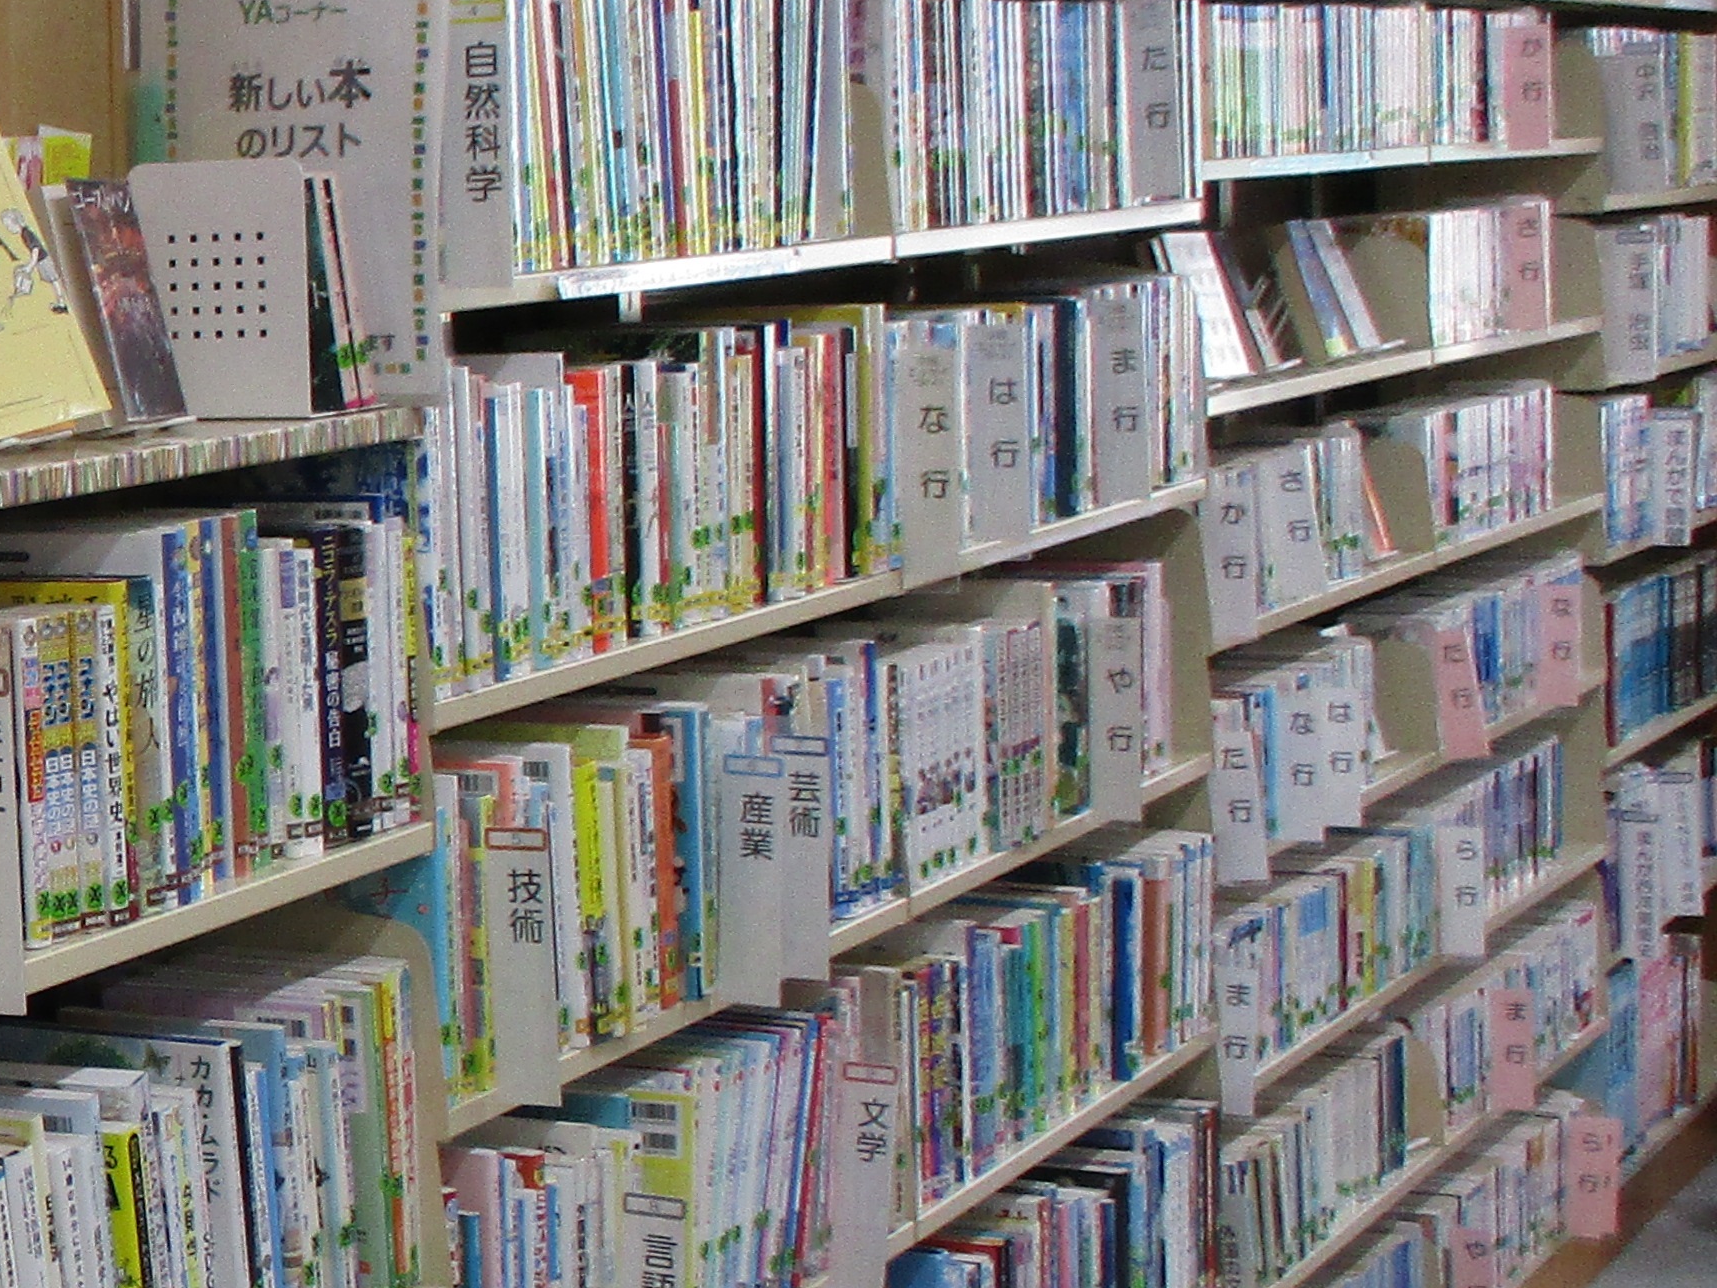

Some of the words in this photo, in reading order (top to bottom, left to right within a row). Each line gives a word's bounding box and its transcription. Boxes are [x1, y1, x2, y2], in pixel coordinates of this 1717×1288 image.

[238, 0, 348, 25] YAコーナー
[229, 58, 373, 112] 新しい本
[464, 41, 502, 203] 自然科学
[236, 122, 363, 160] のリスト
[987, 375, 1020, 469] は行
[1111, 346, 1138, 433] ま行
[918, 404, 952, 500] な行
[1219, 501, 1248, 581] か行
[1279, 468, 1312, 543] さ行
[1106, 666, 1134, 752] や行
[1327, 699, 1355, 774] は行
[1219, 746, 1253, 824] た行
[1289, 711, 1315, 787] な行
[739, 791, 774, 861] 産業
[787, 770, 821, 839] 芸術
[508, 868, 545, 946] 技術
[1222, 983, 1251, 1061] ま行
[855, 1097, 895, 1162] 文学
